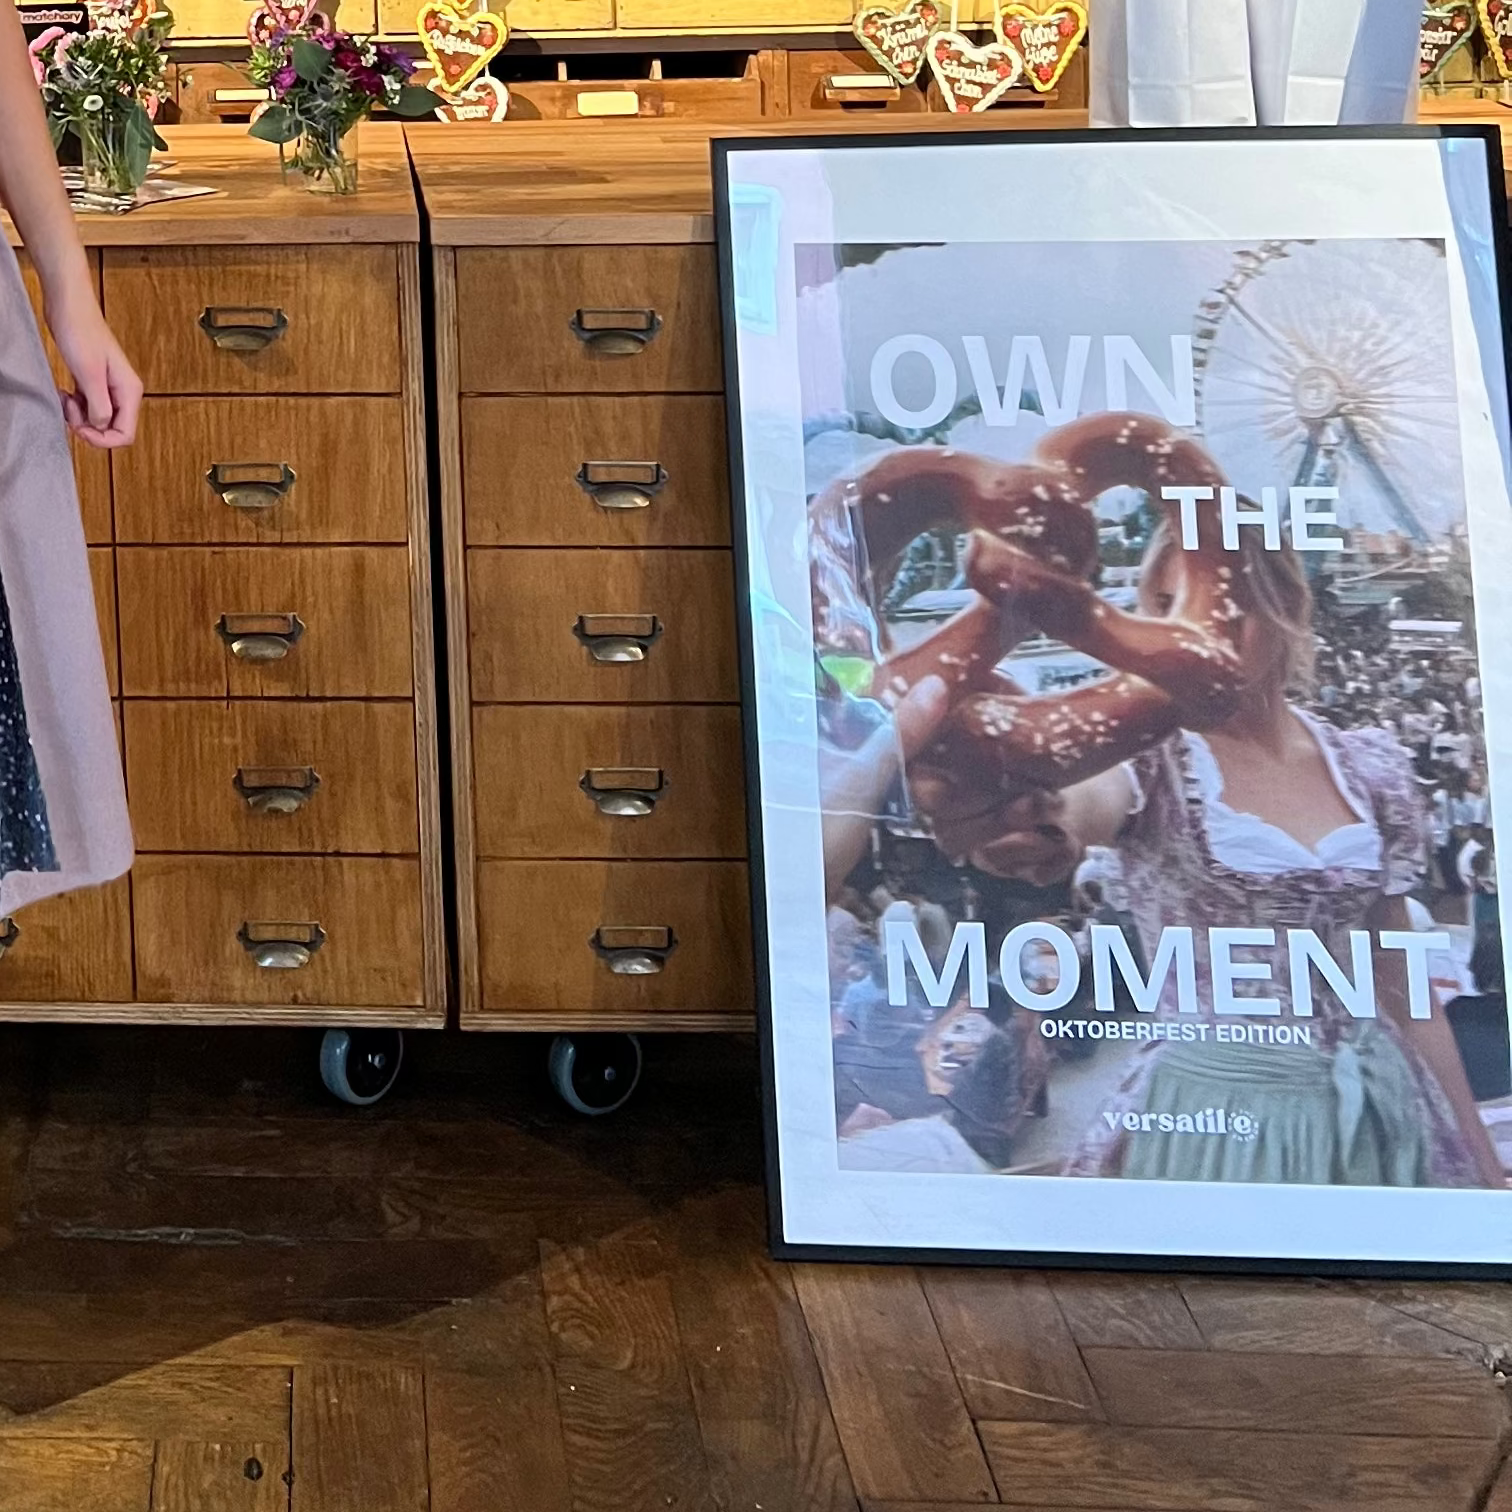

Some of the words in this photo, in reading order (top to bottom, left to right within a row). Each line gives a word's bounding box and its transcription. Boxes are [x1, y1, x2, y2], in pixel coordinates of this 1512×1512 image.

[869, 332, 1197, 429] OWN
[1161, 485, 1346, 551] THE
[884, 920, 1452, 1021] MOMENT
[1040, 1018, 1210, 1042] OKTOBERFEST
[1216, 1023, 1312, 1045] EDITION
